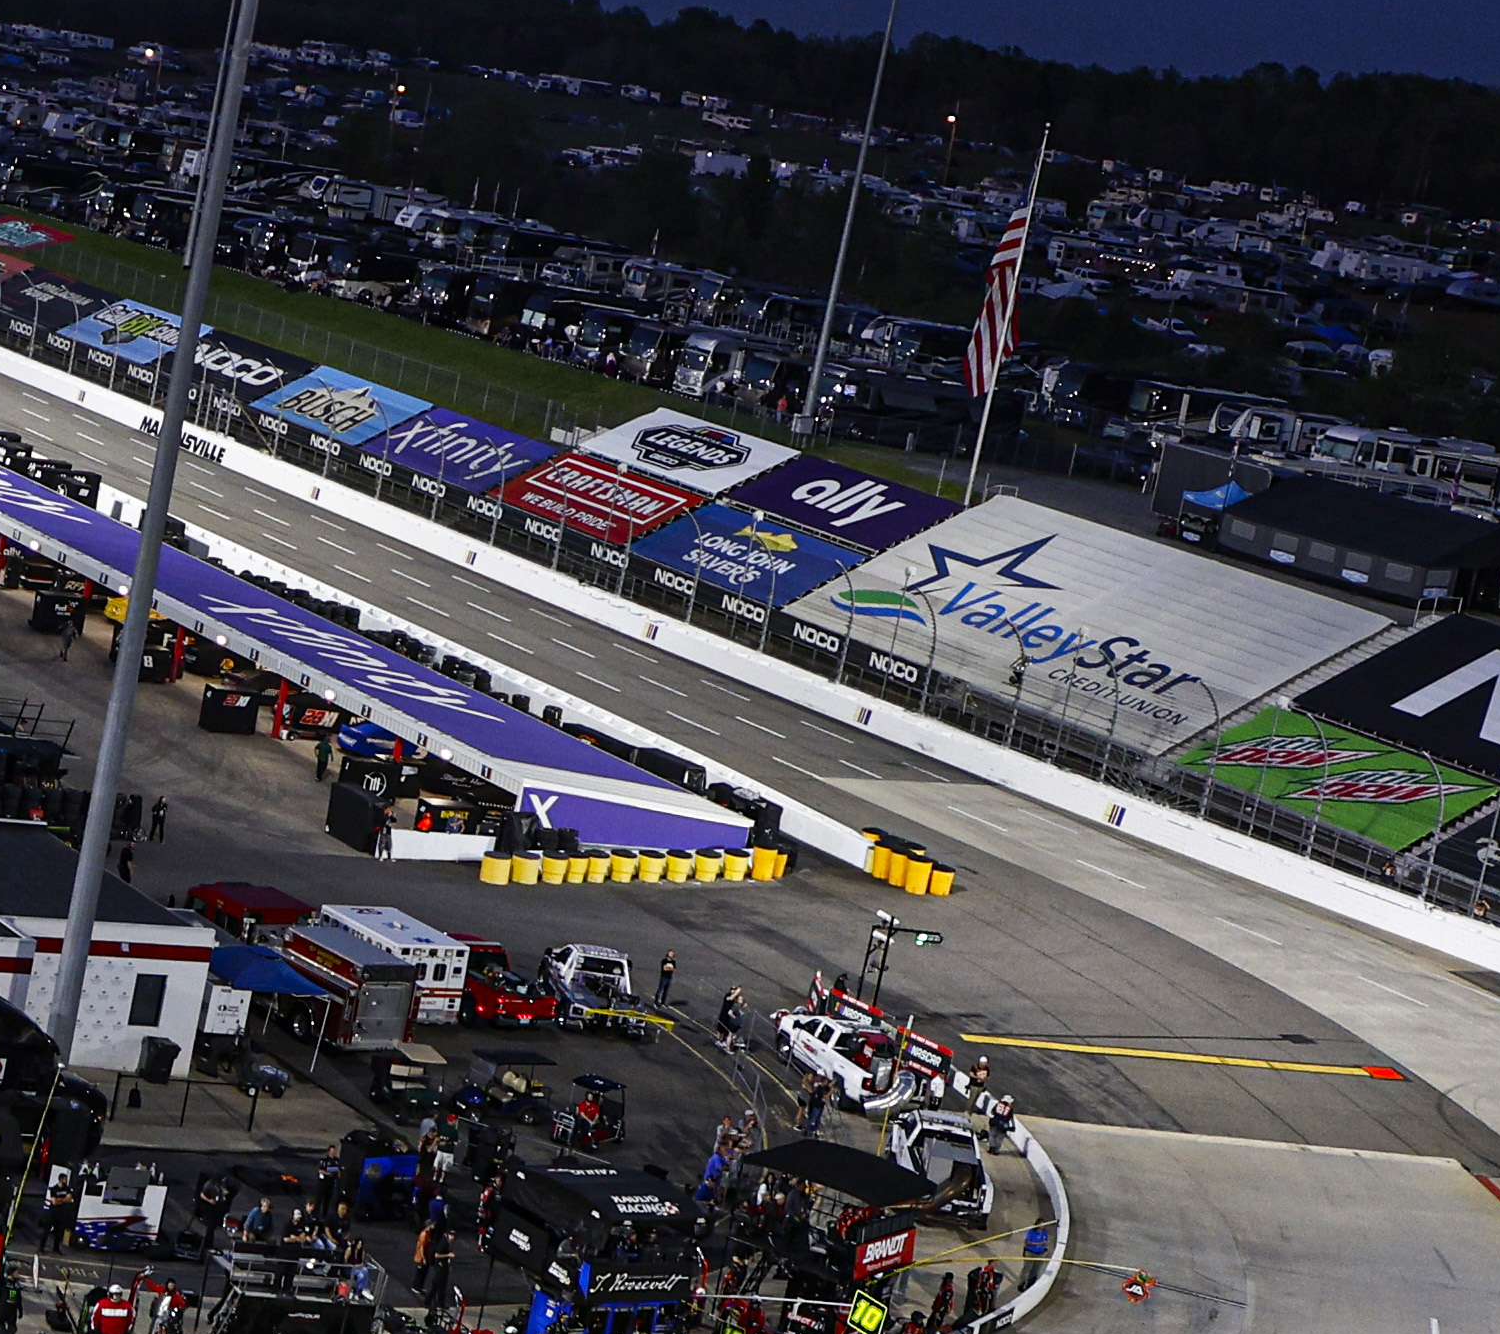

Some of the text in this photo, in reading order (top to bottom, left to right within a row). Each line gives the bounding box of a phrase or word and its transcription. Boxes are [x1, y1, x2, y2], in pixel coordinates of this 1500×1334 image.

[9, 320, 33, 337] NOCO
[47, 333, 71, 351] NOCO
[88, 349, 113, 367] NOCO
[194, 339, 286, 386] NOCO
[128, 364, 154, 384] NOCO
[258, 414, 288, 435] NOCO
[284, 388, 379, 433] BUSCH
[310, 433, 341, 456] NOCO
[389, 419, 529, 481] xfinity
[646, 429, 739, 466] LEGENDS
[359, 453, 392, 477] NOCO
[412, 473, 446, 497] NOCO
[545, 466, 666, 517] CRAFTSMAN
[467, 496, 503, 521] NOCO
[522, 491, 610, 532] WE BUILD PRIDE
[792, 477, 907, 527] ally
[525, 517, 562, 543] NOCO
[591, 542, 629, 568] NOCO
[682, 548, 761, 586] SILVER'S
[694, 532, 797, 576] LONG JOHN
[655, 568, 695, 594] NOCO
[722, 594, 765, 624] NOCO
[794, 622, 839, 653] NOCO
[937, 581, 1201, 698] ValleyStar
[870, 651, 918, 683] NOCO
[1048, 666, 1188, 726] CREDIT UNION
[911, 1044, 942, 1067] NASCAR
[862, 1233, 909, 1266] BRANDT
[614, 1272, 689, 1293] Roosevelt
[855, 1300, 884, 1333] 10
